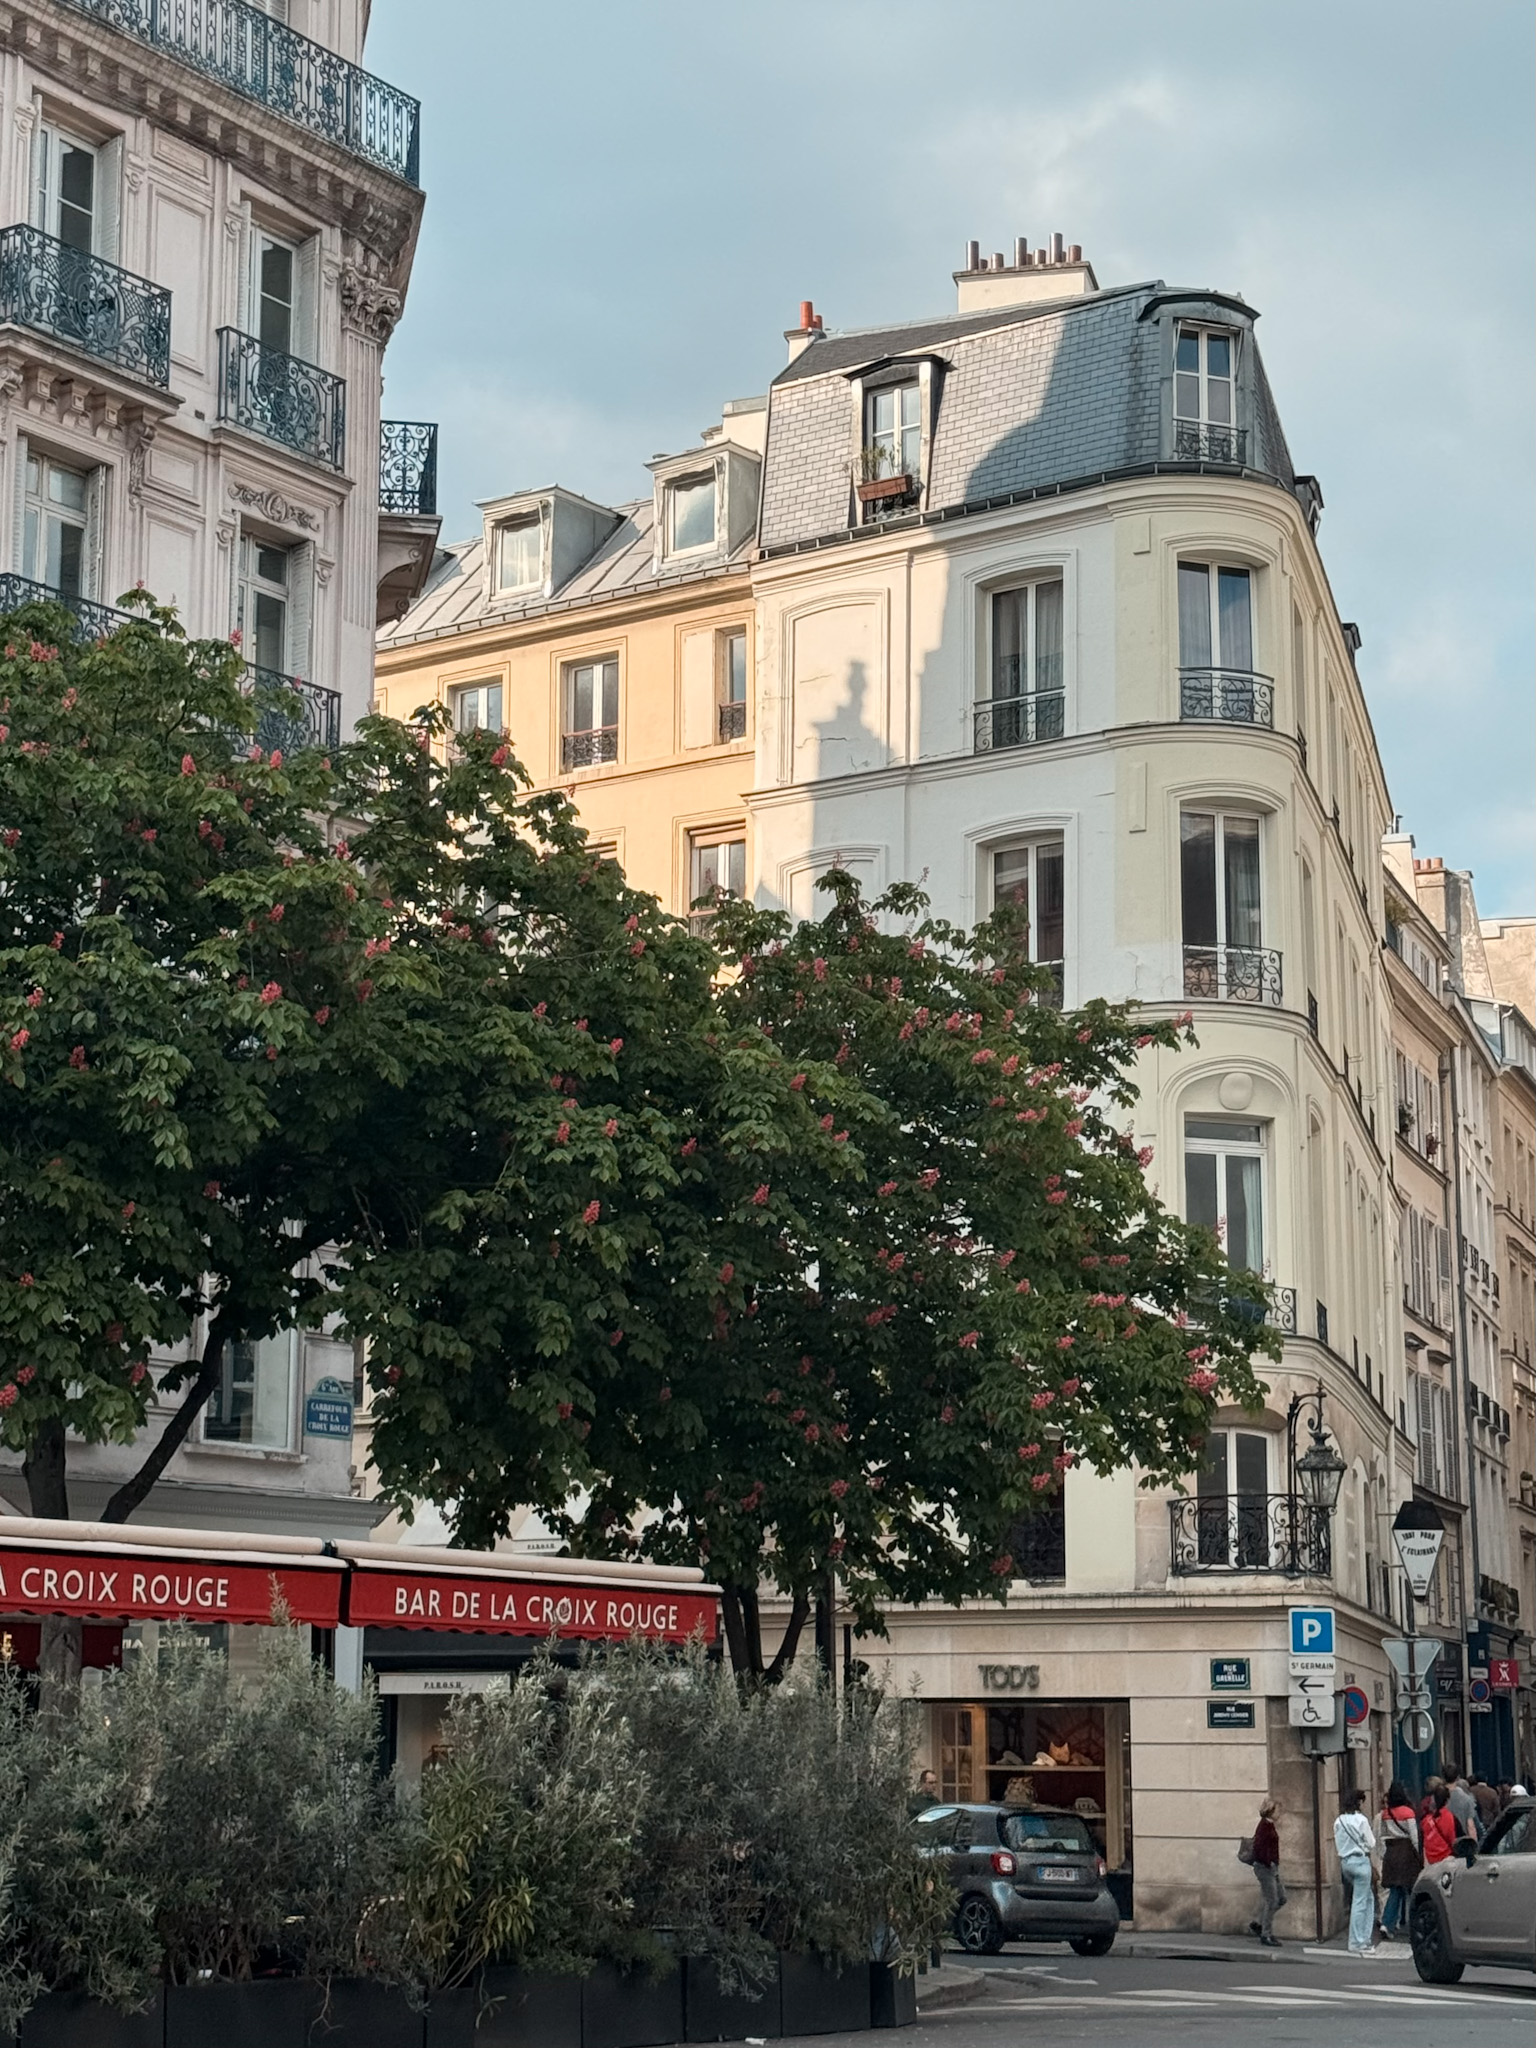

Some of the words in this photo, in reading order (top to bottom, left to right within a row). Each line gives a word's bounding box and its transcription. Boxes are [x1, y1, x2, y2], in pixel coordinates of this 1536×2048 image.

[319, 1413, 328, 1421] DE
[330, 1414, 339, 1423] LA
[1420, 1532, 1436, 1541] POUR
[20, 1567, 119, 1602] CROIX
[132, 1573, 229, 1608] ROUGE
[395, 1587, 441, 1617] BAR
[452, 1591, 481, 1619] DE
[490, 1593, 517, 1621] LA
[526, 1595, 598, 1626] CROIX
[606, 1601, 679, 1631] ROUGE
[1302, 1618, 1322, 1647] P
[1222, 1664, 1237, 1672] RUE
[1300, 1662, 1334, 1670] GERMAIN
